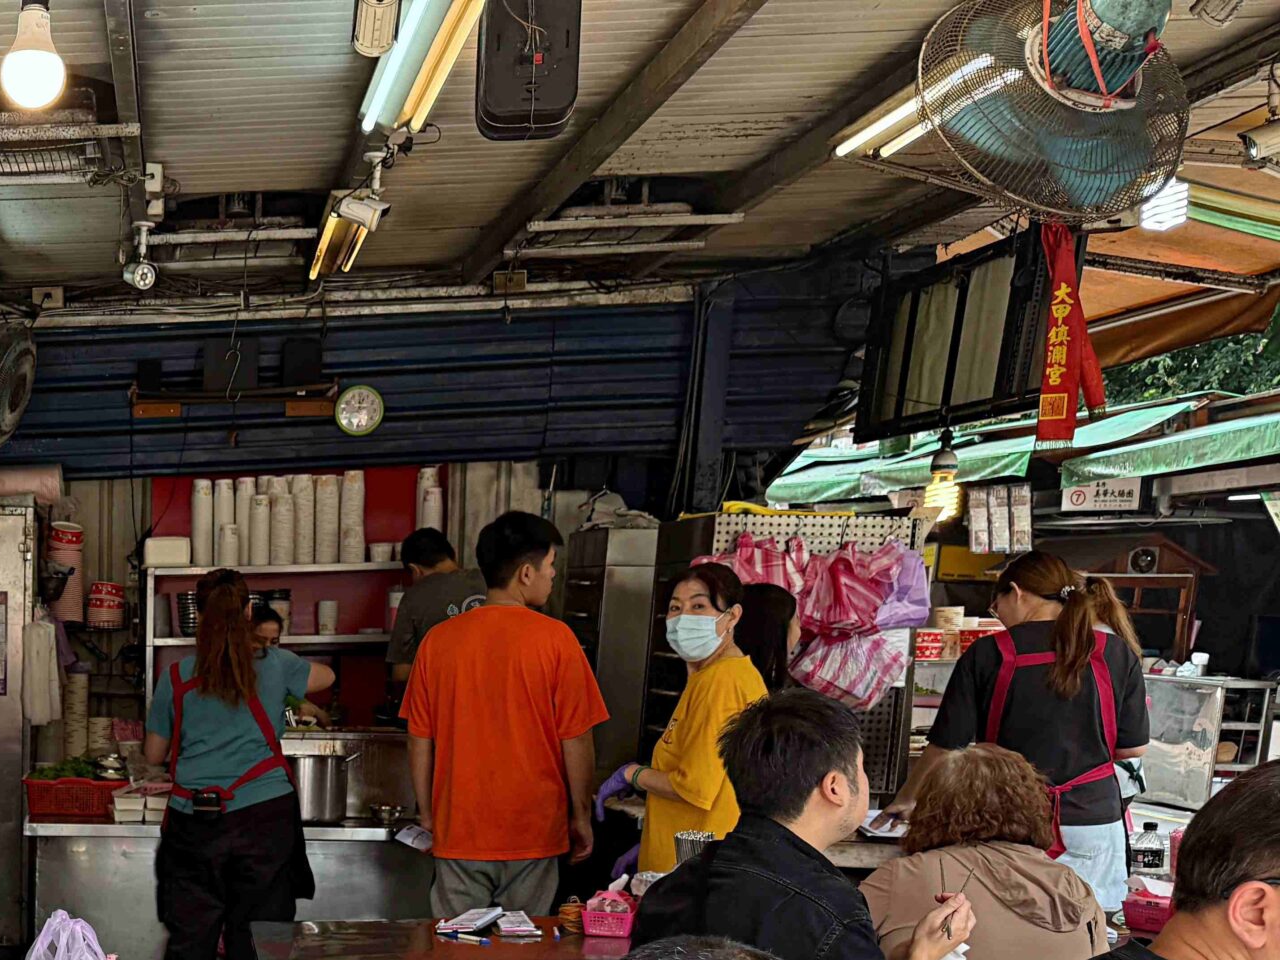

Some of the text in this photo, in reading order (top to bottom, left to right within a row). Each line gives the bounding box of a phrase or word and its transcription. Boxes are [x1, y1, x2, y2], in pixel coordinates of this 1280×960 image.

[1046, 281, 1074, 386] 大甲鎮瀾宮
